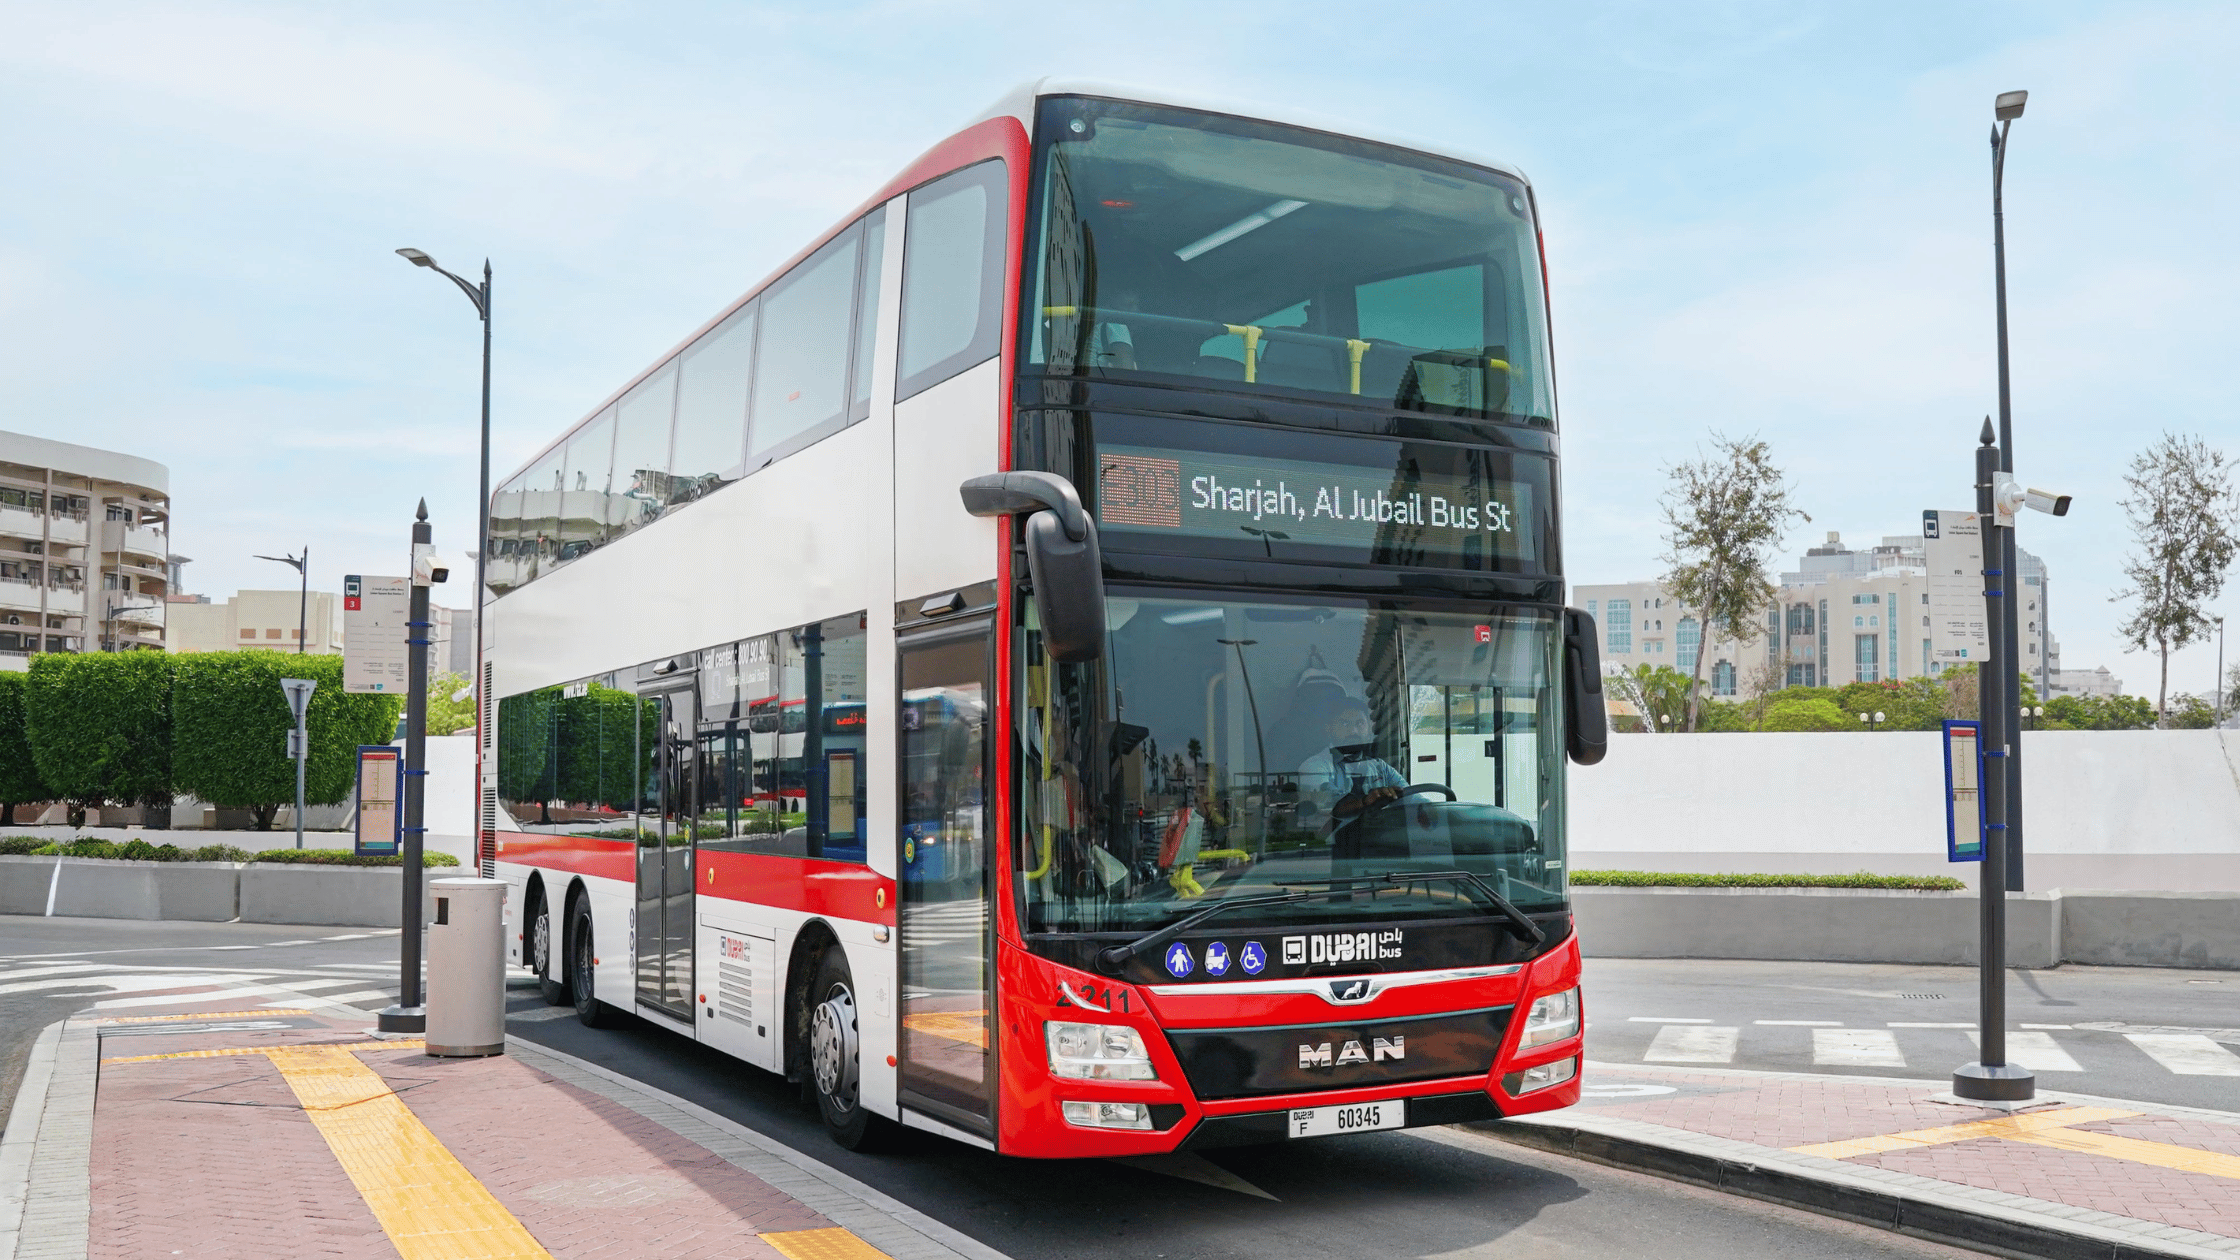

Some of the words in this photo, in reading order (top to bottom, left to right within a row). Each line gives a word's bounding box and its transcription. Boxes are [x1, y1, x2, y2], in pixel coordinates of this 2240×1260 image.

[1191, 476, 1305, 521] Sharjah,
[1312, 486, 1344, 519] Al
[1348, 489, 1425, 526] Jubail
[1430, 496, 1480, 530] Bus
[1485, 501, 1512, 533] St
[349, 600, 355, 608] 3
[738, 643, 750, 666] 800
[750, 641, 759, 664] 90
[759, 638, 768, 662] 90
[1310, 932, 1377, 965] DUBAI
[1379, 945, 1402, 959] bus
[1378, 927, 1403, 944] باص
[1298, 1035, 1405, 1068] MAN
[1300, 1122, 1308, 1135] F
[1337, 1105, 1380, 1129] 60345
